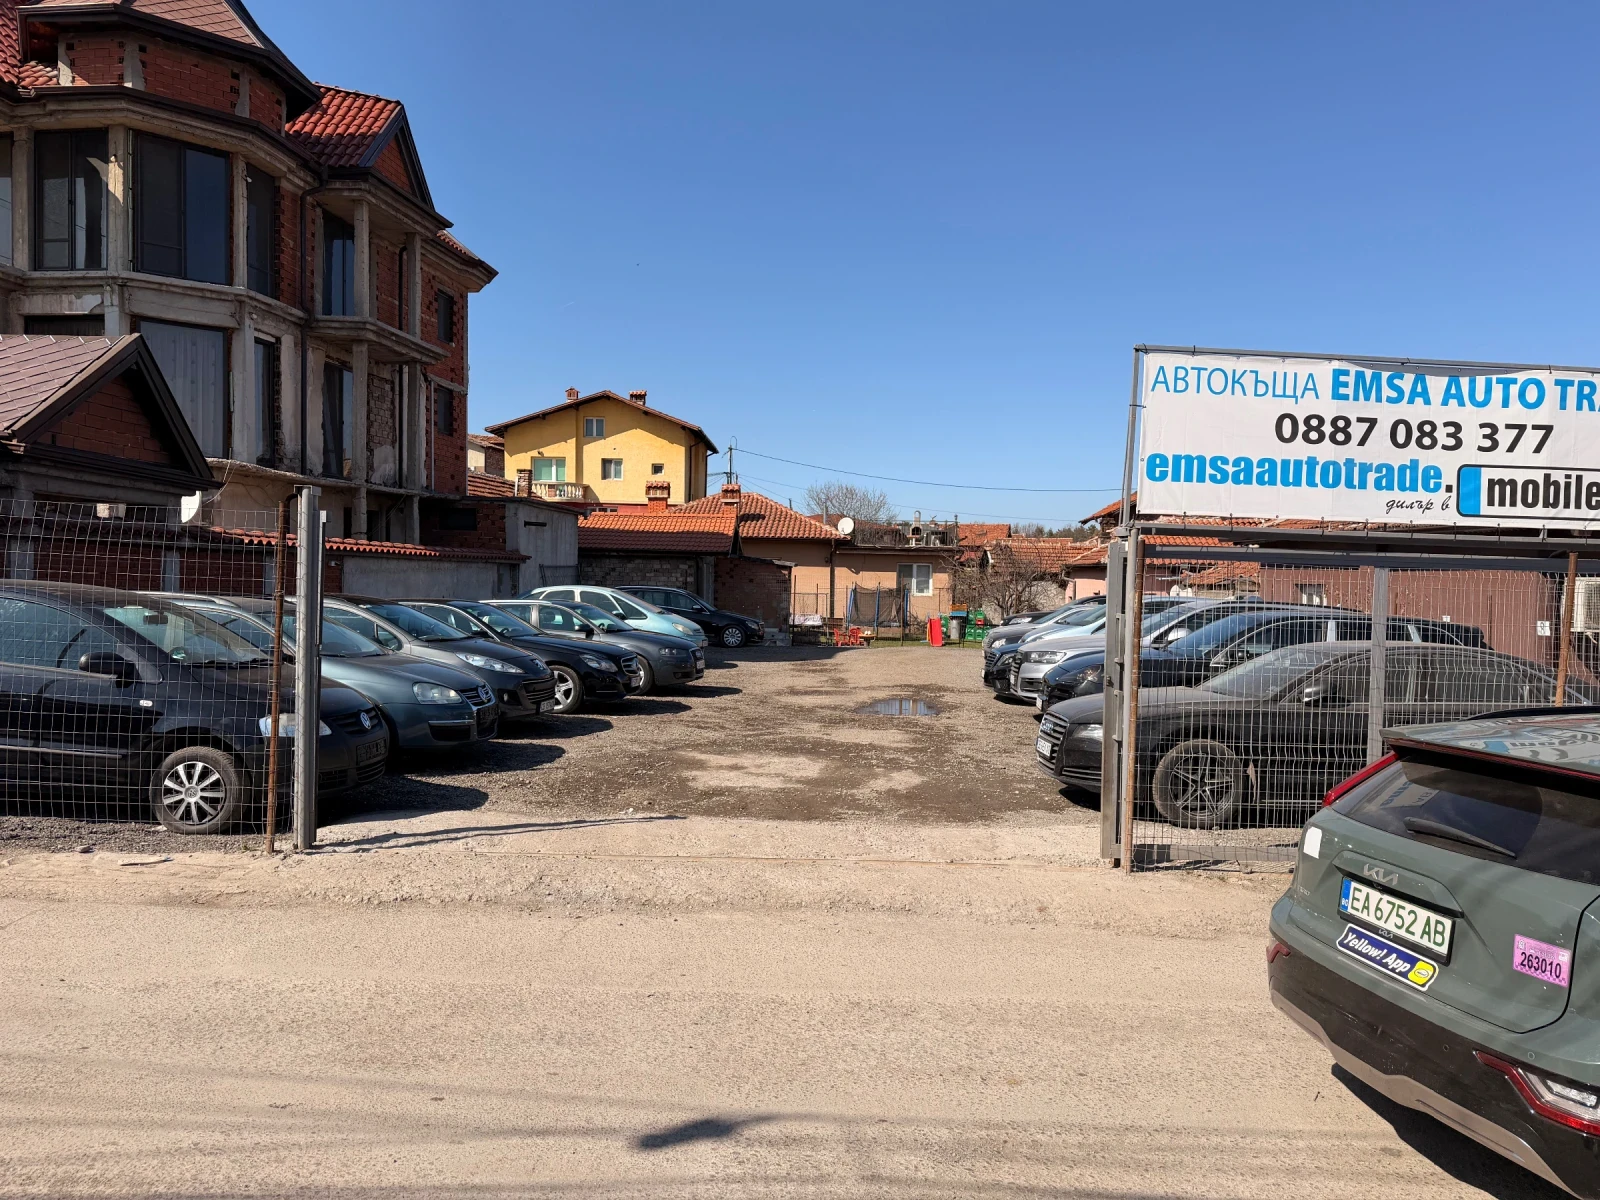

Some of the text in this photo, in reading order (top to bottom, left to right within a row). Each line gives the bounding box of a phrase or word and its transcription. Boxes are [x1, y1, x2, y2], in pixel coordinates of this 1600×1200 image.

[1150, 365, 1600, 412] АВТОКЪЩА EMSA AUTO TR
[1274, 412, 1554, 454] 0887 083 377
[1374, 897, 1418, 936] 6752
[1420, 916, 1446, 947] AB
[1343, 932, 1412, 973] Yellow! App
[1520, 951, 1562, 979] 263010
